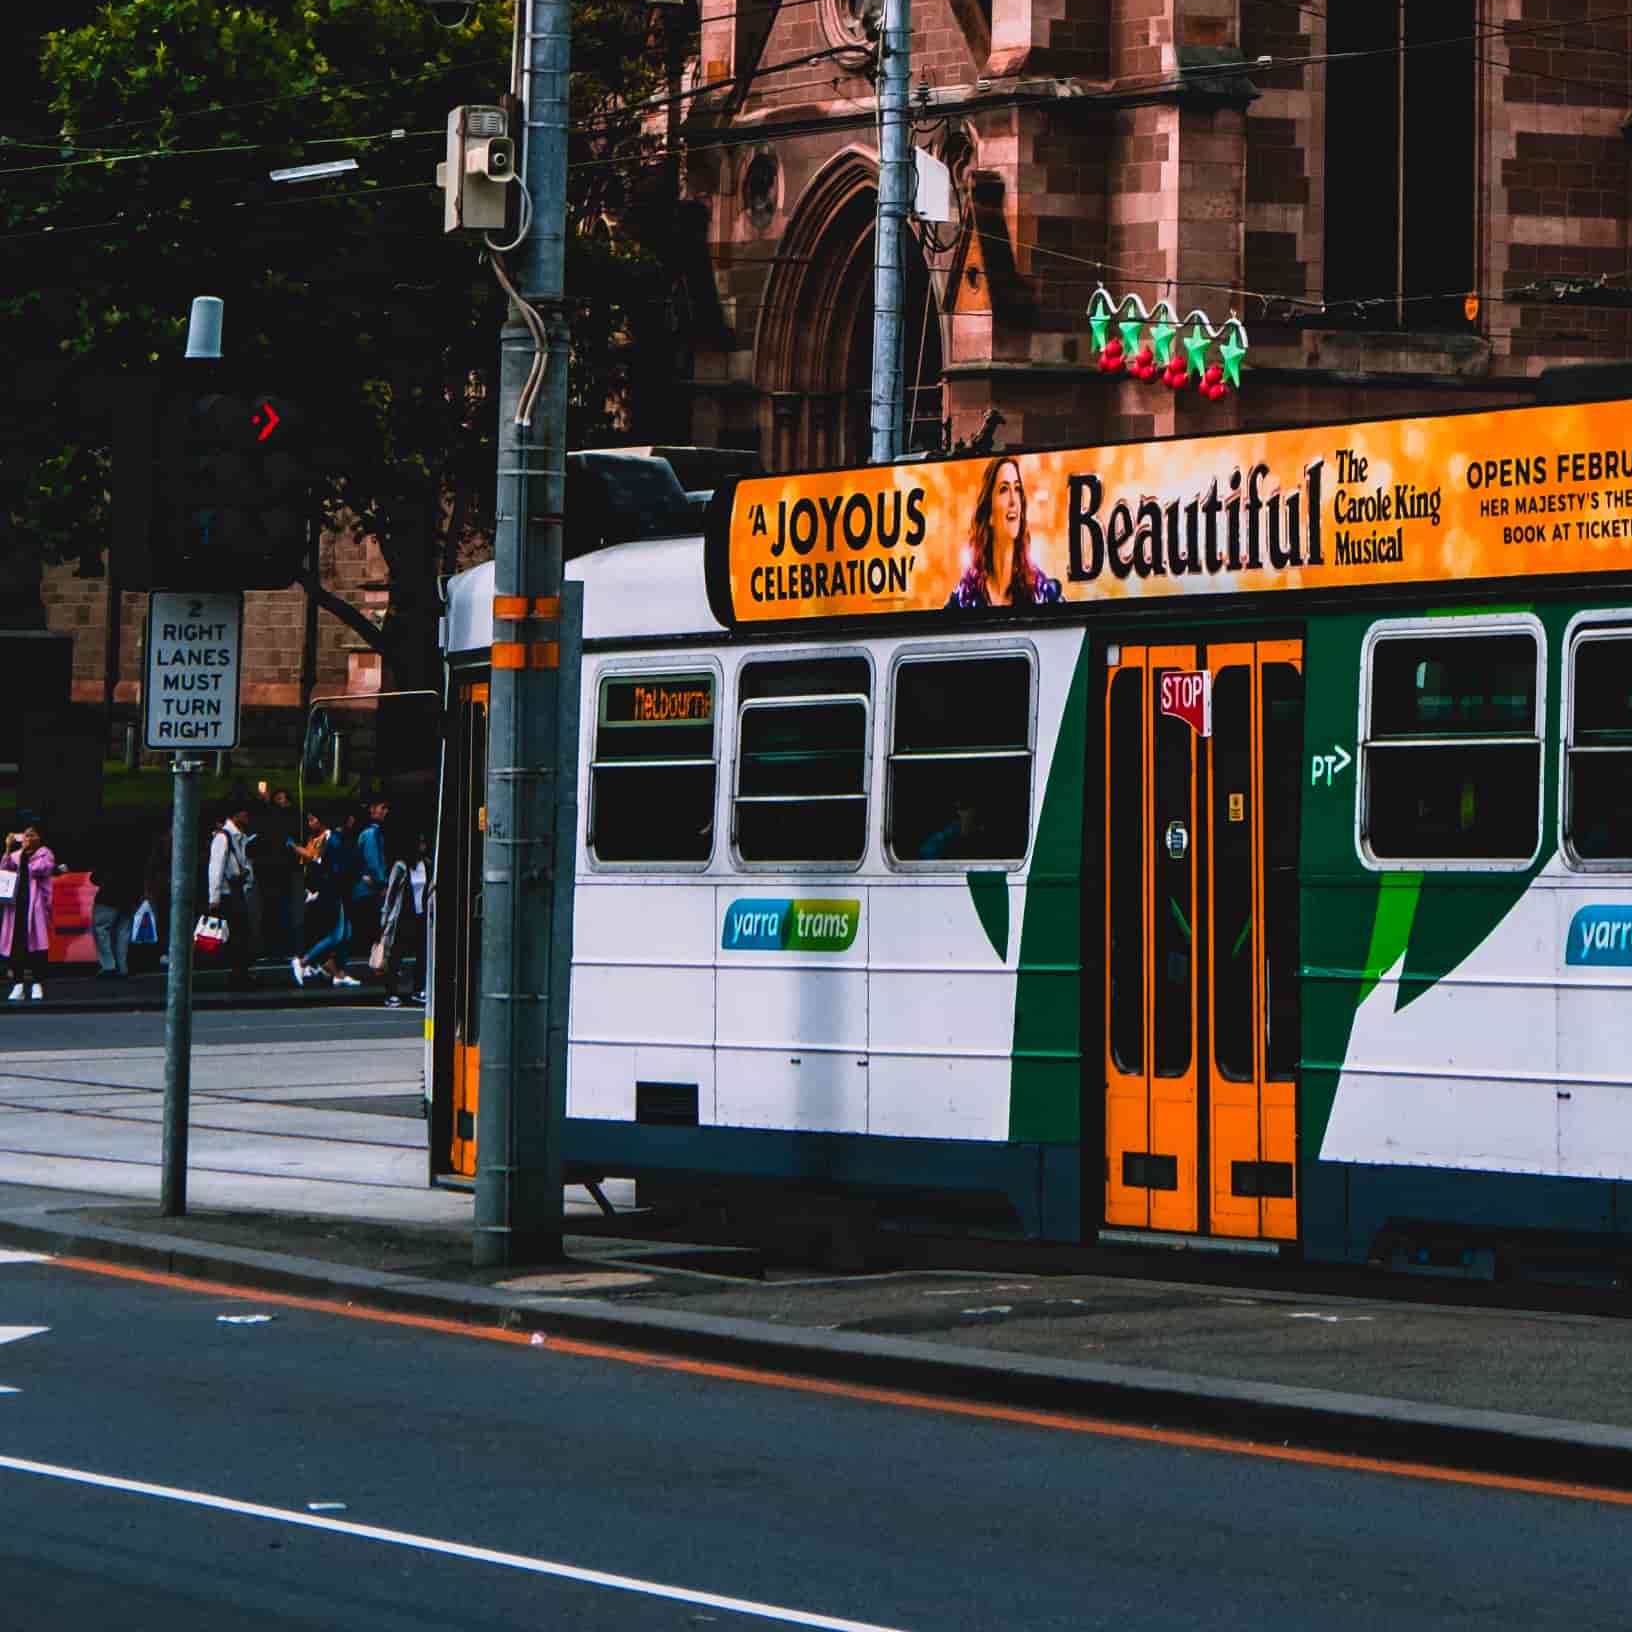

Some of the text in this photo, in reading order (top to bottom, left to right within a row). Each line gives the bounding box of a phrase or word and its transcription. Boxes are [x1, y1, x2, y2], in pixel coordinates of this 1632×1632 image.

[1336, 448, 1368, 484] The
[1466, 455, 1547, 490] OPENS
[1067, 456, 1325, 583] Beautiful
[1334, 485, 1441, 527] Carole King
[1480, 497, 1510, 518] HER
[1514, 491, 1600, 514] MAJESTY'S
[771, 487, 926, 557] JOYOUS
[1502, 524, 1546, 545] BOOK
[1551, 521, 1573, 542] AT
[1334, 527, 1404, 567] Musical
[188, 599, 204, 618] 2
[163, 624, 227, 641] RIGHT
[157, 648, 231, 667] LANES
[163, 674, 223, 691] MUST
[1161, 676, 1203, 710] STOP
[163, 699, 221, 716] TURN
[159, 721, 224, 738] RIGHT
[732, 907, 849, 943] yarra trams
